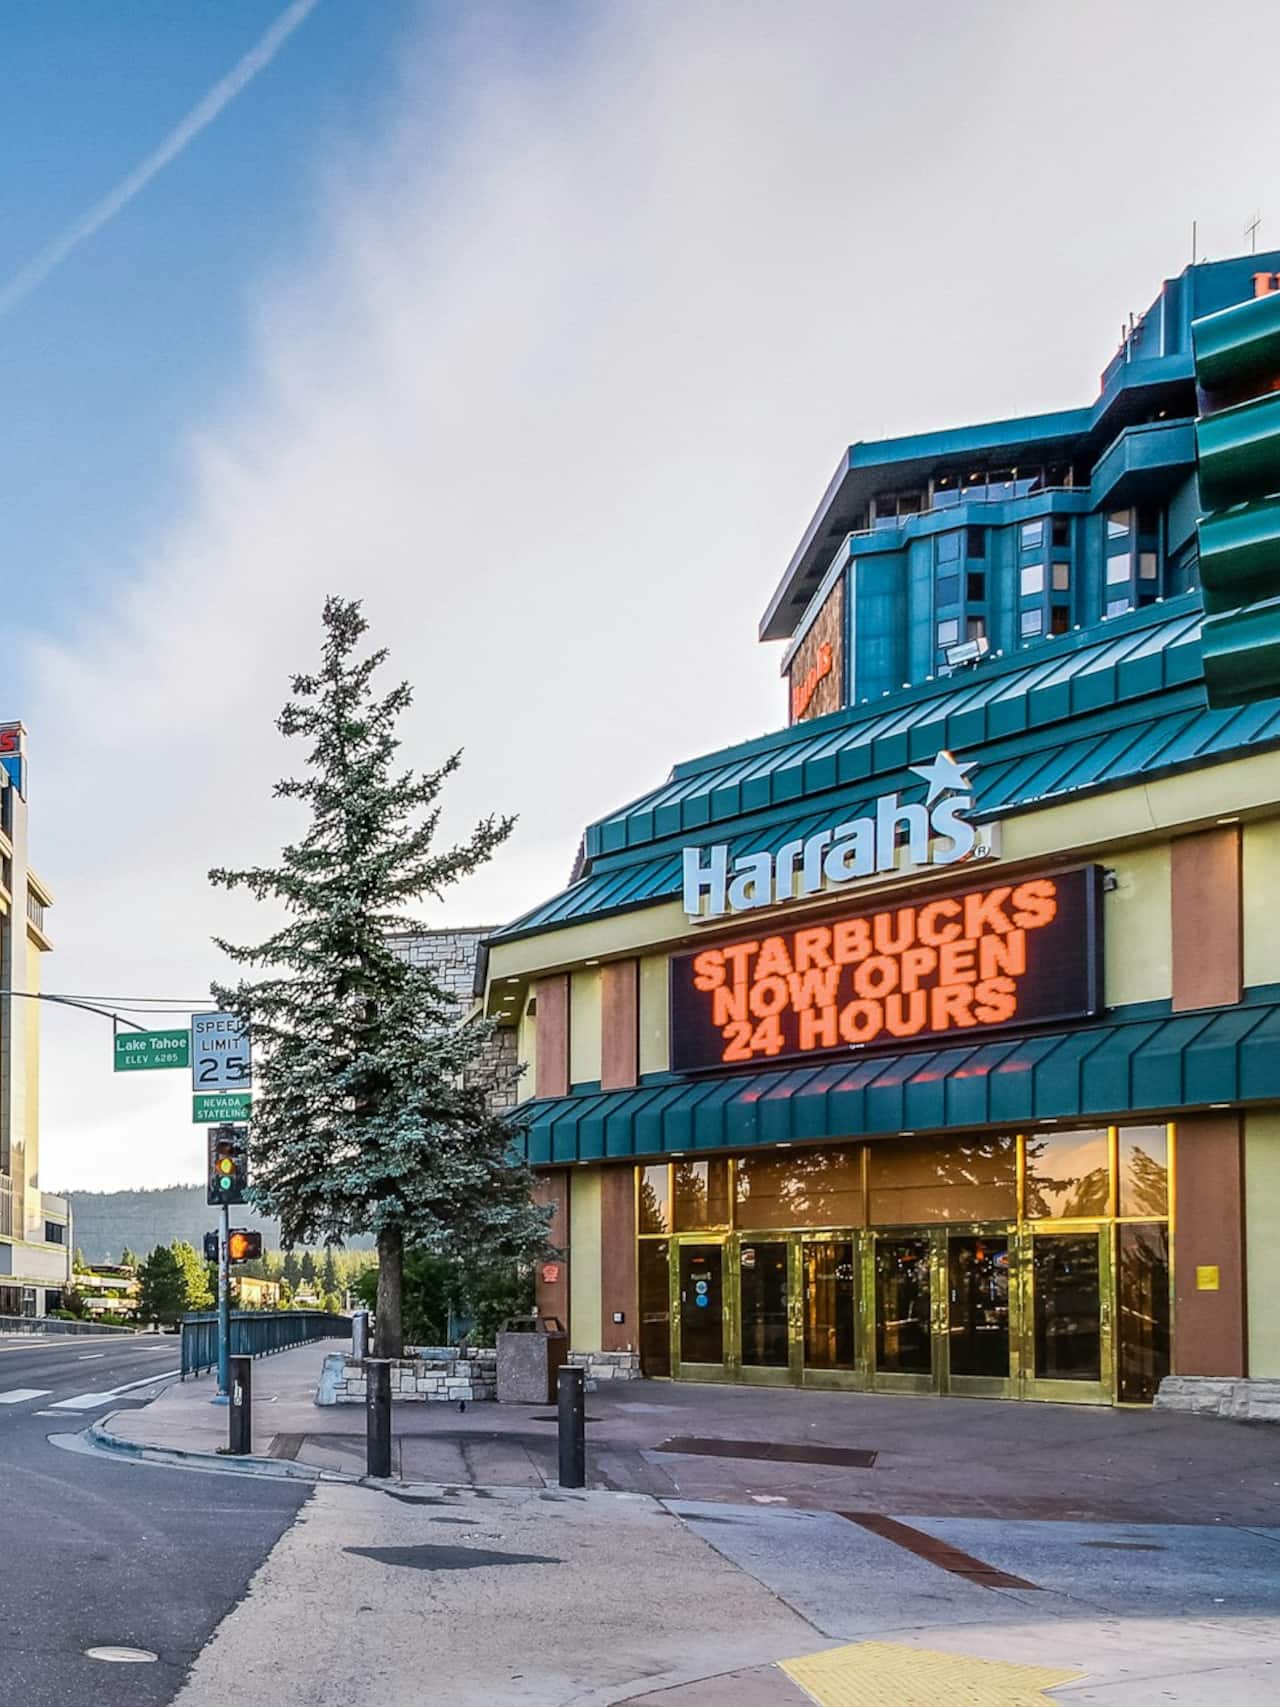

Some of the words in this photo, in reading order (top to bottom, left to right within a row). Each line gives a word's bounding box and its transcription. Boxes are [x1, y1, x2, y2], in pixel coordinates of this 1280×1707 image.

[694, 879, 1057, 991] STARBUCKS
[712, 963, 841, 1026] NOW
[853, 929, 1026, 999] OPEN
[722, 1015, 784, 1061] 24
[800, 976, 1017, 1050] HOURS
[196, 1020, 246, 1033] SPEED
[116, 1039, 147, 1052] Lake
[149, 1037, 187, 1050] Tahoe
[202, 1038, 240, 1051] LIMIT
[125, 1055, 149, 1065] ELEV
[199, 1056, 245, 1082] 25
[203, 1098, 241, 1108] NEVADA
[197, 1108, 247, 1119] STATELINE
